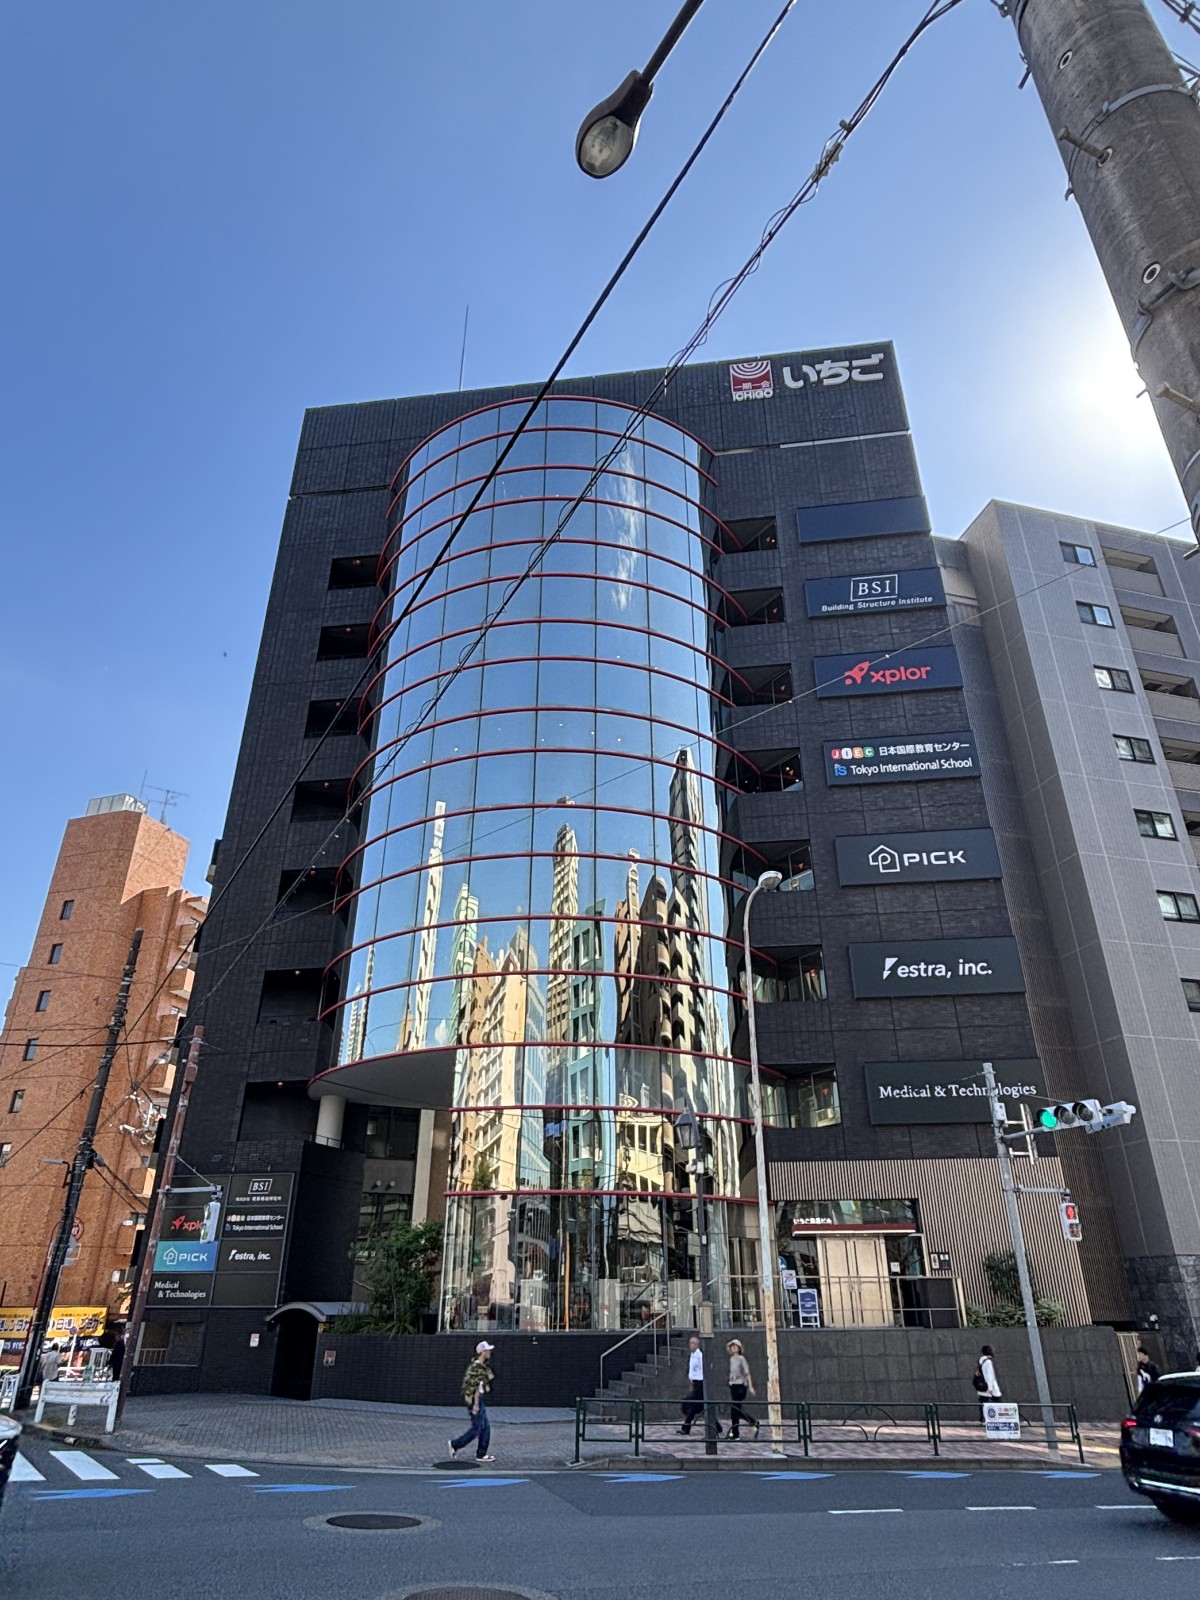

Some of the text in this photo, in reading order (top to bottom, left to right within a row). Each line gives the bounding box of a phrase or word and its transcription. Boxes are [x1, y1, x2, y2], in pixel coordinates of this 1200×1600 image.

[783, 353, 884, 389] いちご
[732, 389, 774, 402] ICHIGO
[858, 580, 891, 596] BSI
[821, 596, 933, 612] Building Structure Institute
[870, 666, 931, 684] xplor
[831, 741, 970, 760] JIEC 日本国際教育センター
[850, 764, 879, 777] Tokyo
[880, 760, 940, 773] International
[941, 757, 973, 769] School
[903, 850, 967, 866] PICK
[958, 958, 993, 976] inc.
[878, 1084, 931, 1099] Medical
[934, 1085, 947, 1098] &
[252, 1181, 269, 1191] BSI
[179, 1253, 208, 1262] PICK
[257, 1251, 272, 1260] inc.
[154, 1281, 180, 1289] Medical
[165, 1290, 207, 1300] Technologies
